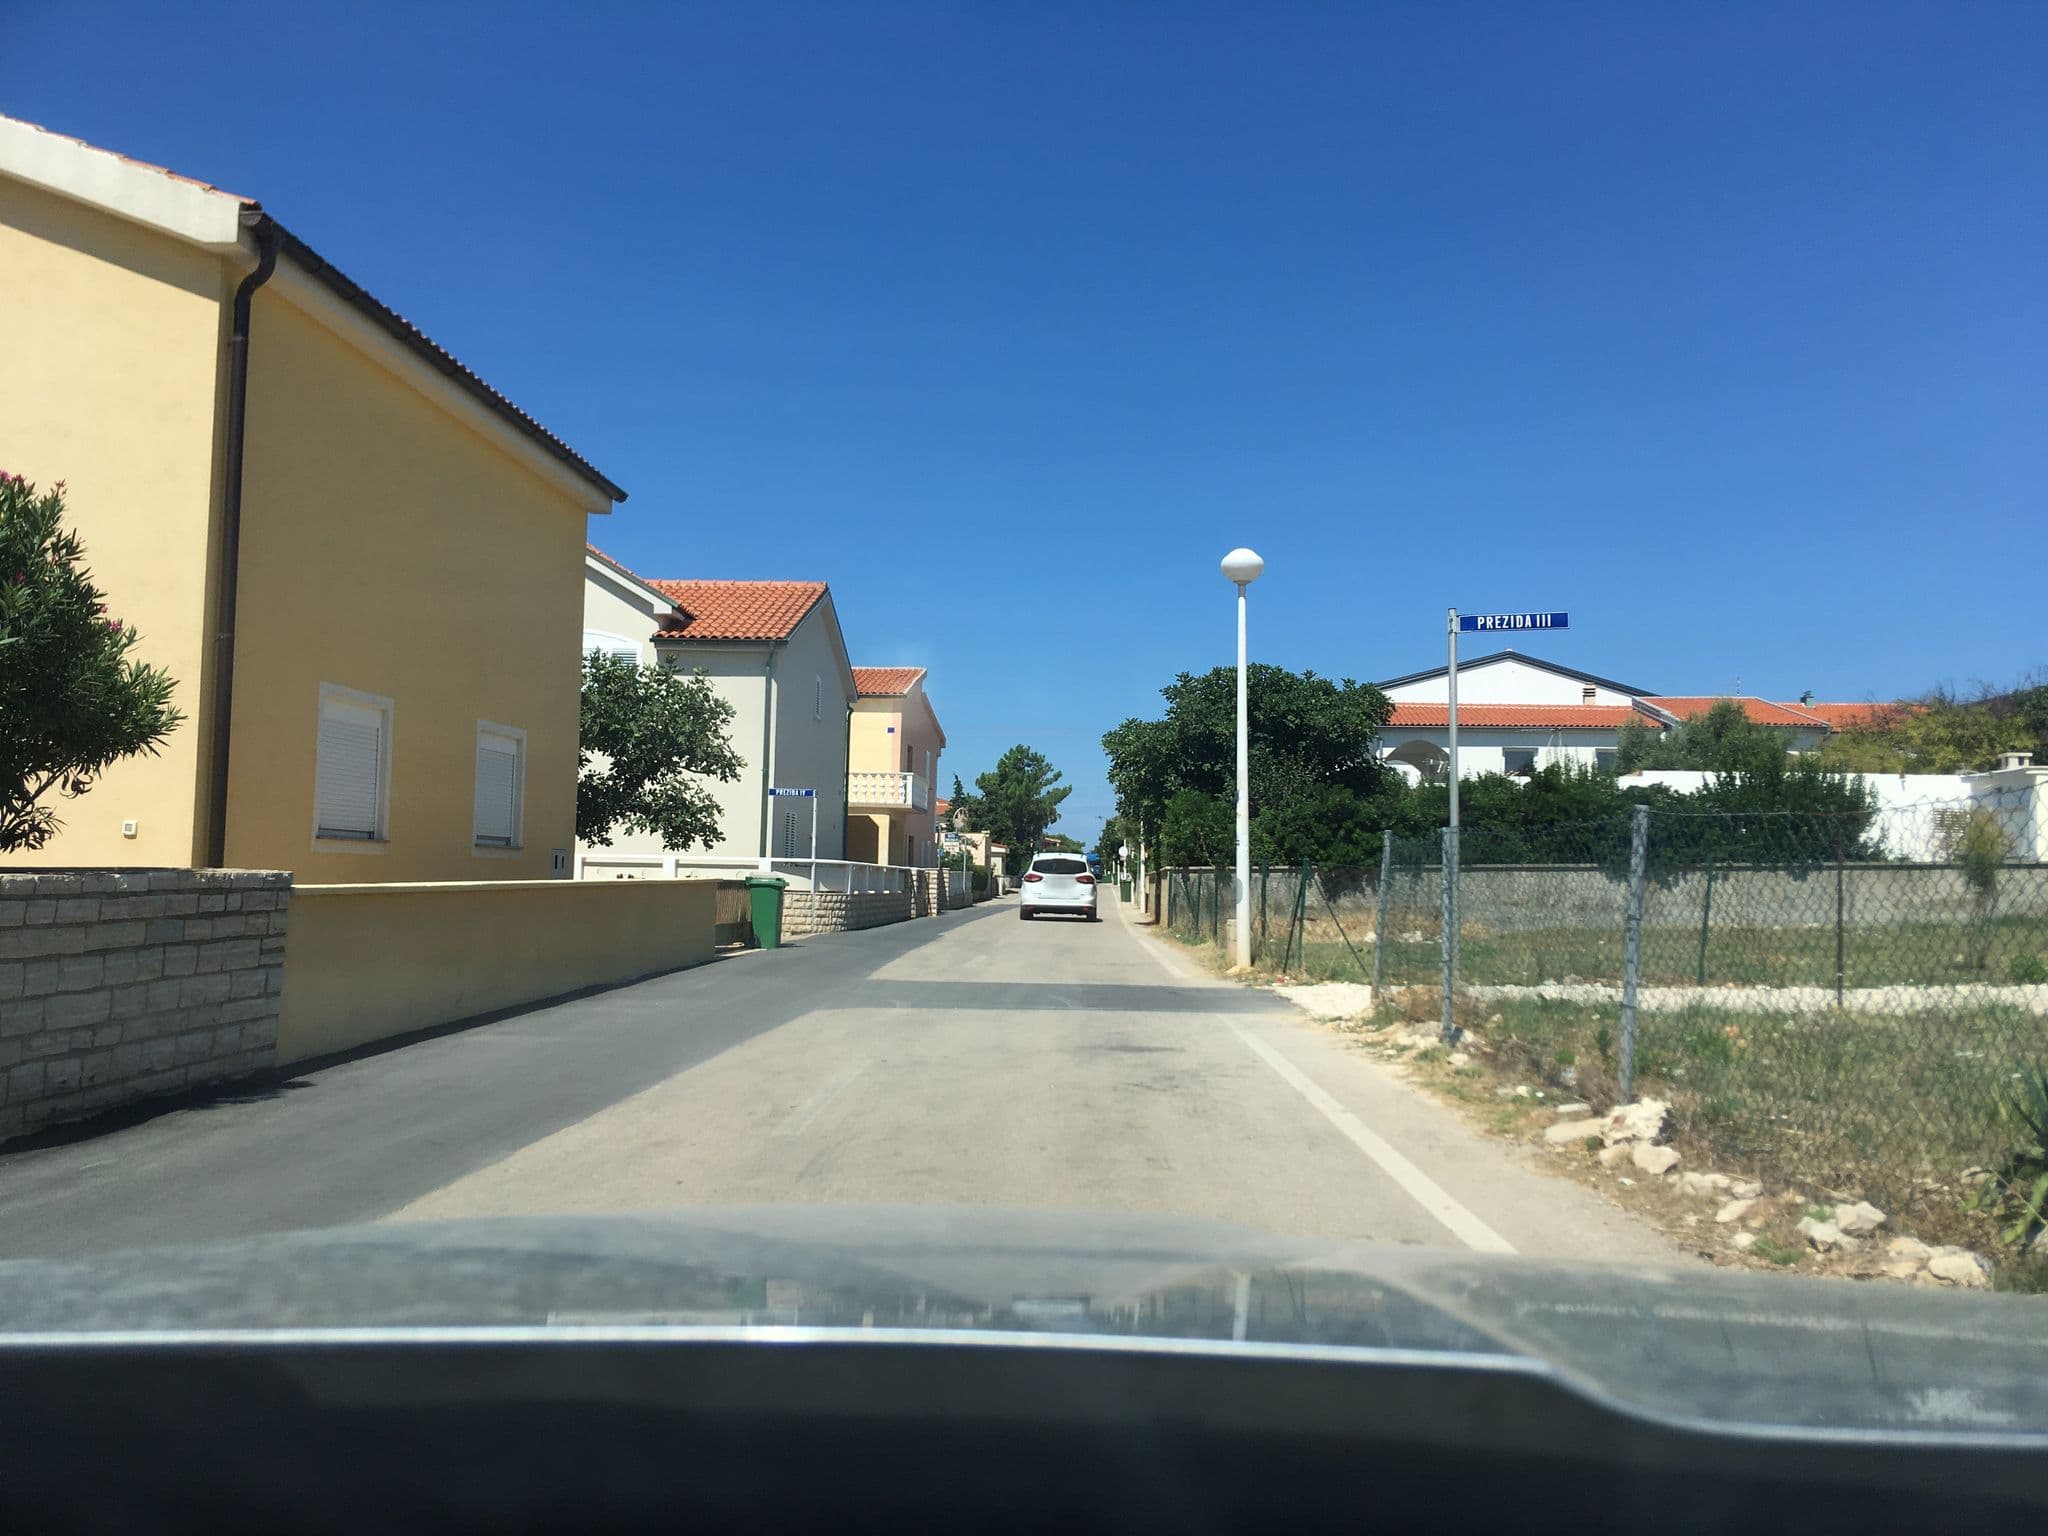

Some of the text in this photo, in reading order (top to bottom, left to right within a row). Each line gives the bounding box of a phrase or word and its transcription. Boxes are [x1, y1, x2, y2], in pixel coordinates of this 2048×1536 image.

[1477, 614, 1552, 630] PREZIDA III
[776, 788, 799, 796] PREZIDA
